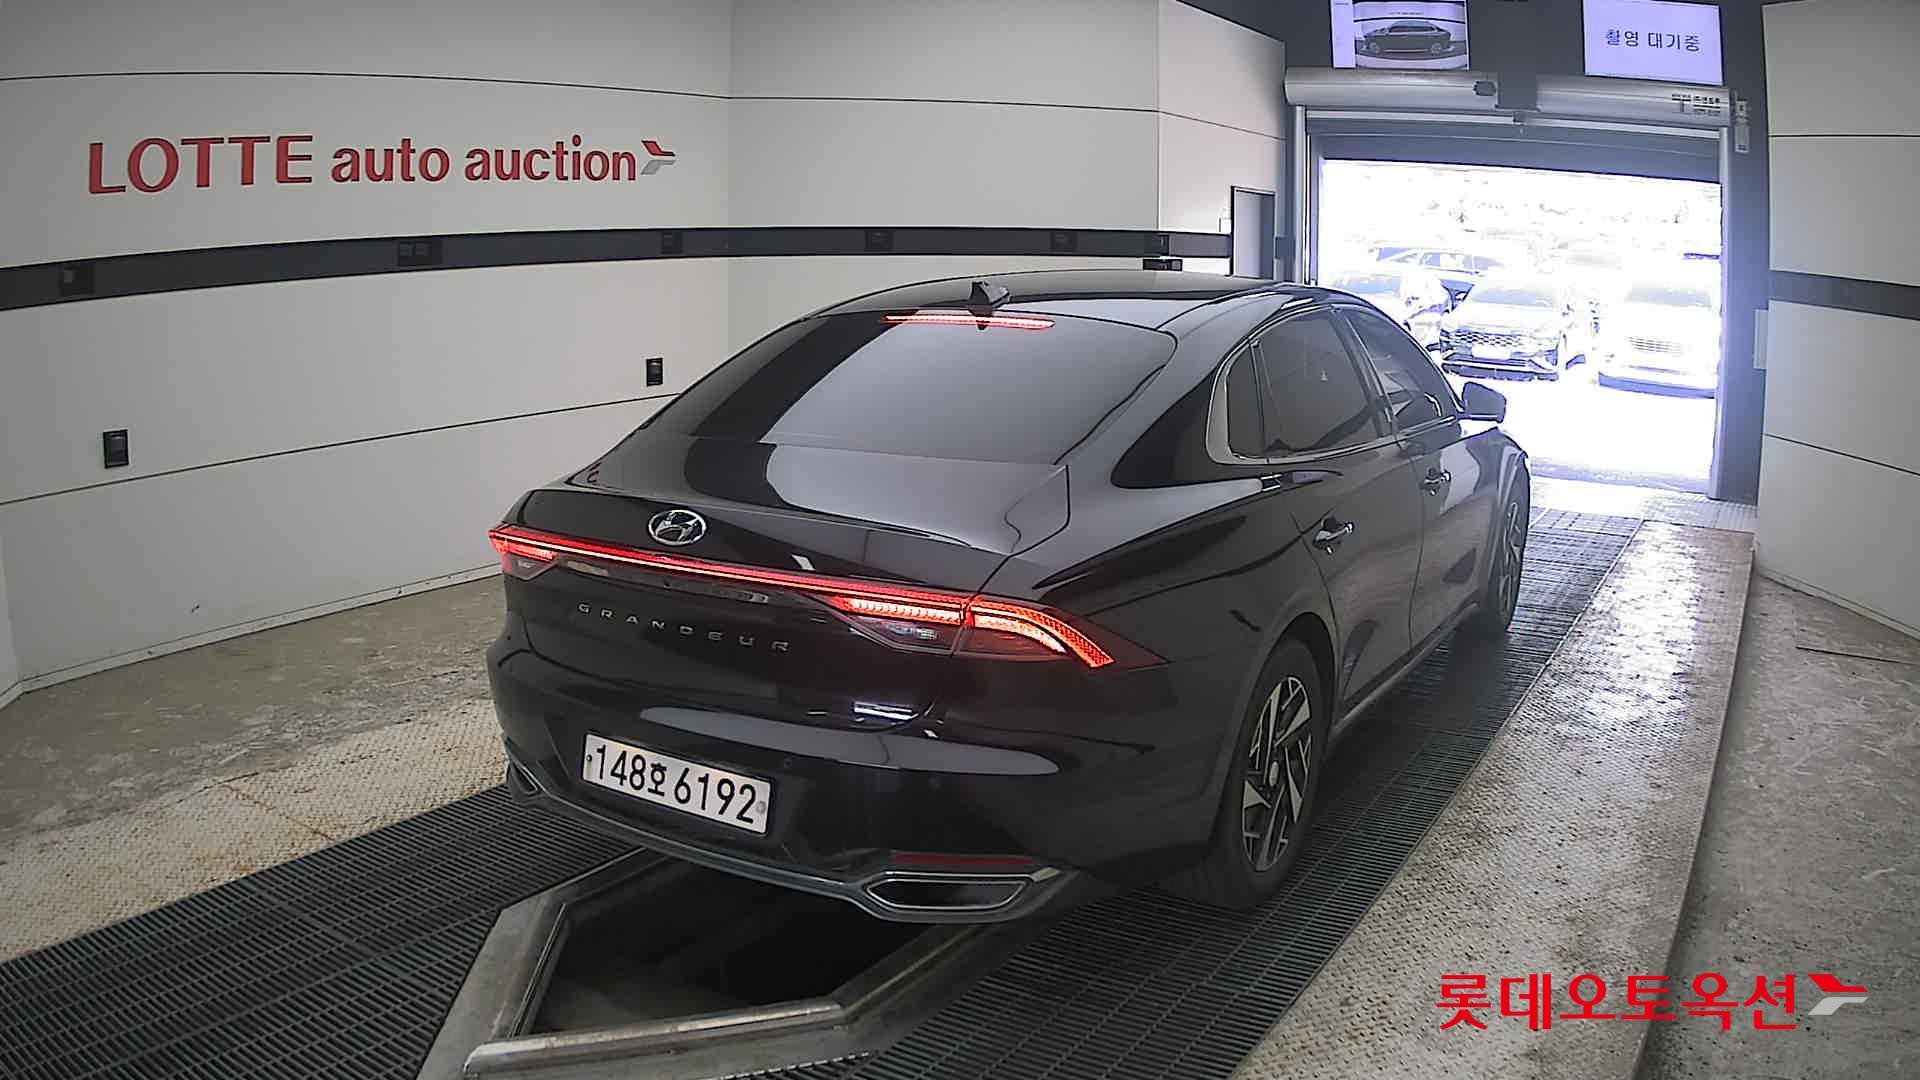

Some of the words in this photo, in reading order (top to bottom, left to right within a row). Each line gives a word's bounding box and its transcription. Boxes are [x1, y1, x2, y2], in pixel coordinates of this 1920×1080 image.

[1606, 28, 1639, 47] 촬영
[1647, 31, 1700, 52] 대기중
[88, 135, 313, 194] LOTTE
[330, 138, 451, 182] auto
[464, 134, 637, 182] auction
[577, 603, 790, 651] GRANDEUR
[596, 744, 757, 824] 148호6192
